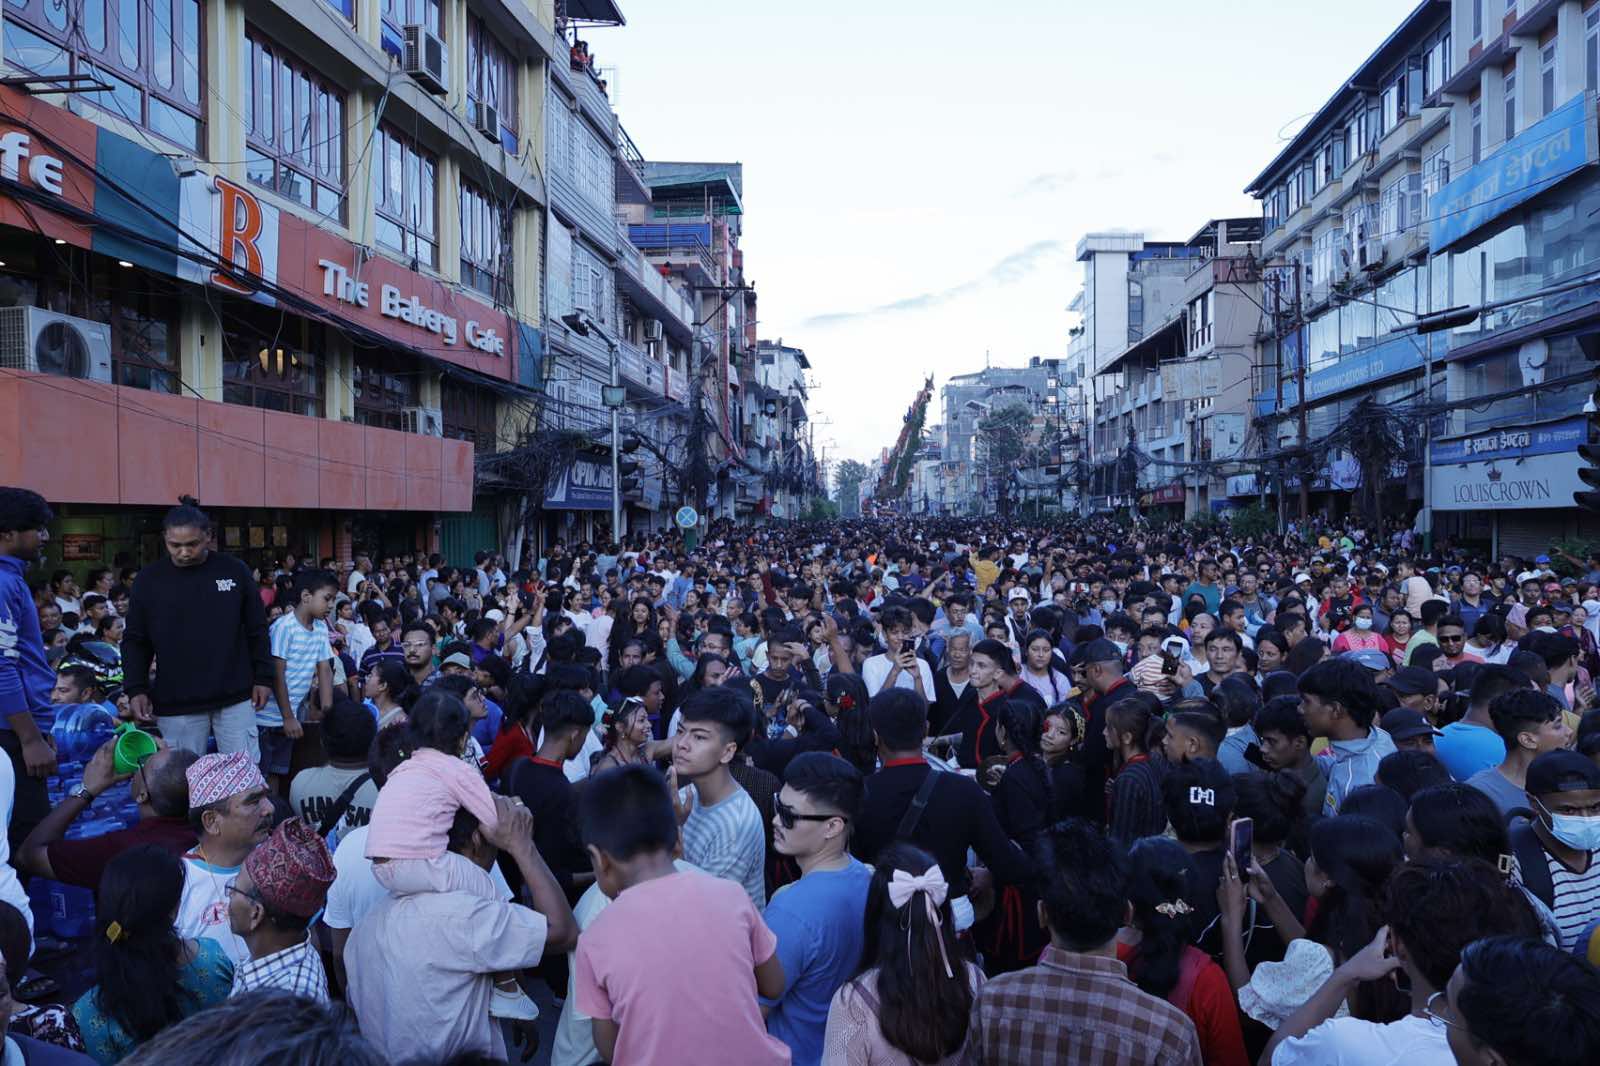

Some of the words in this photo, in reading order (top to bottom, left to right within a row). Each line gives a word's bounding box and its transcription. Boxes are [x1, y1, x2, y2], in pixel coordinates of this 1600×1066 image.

[211, 176, 263, 295] B
[318, 258, 369, 308] The
[381, 283, 457, 345] Bakery
